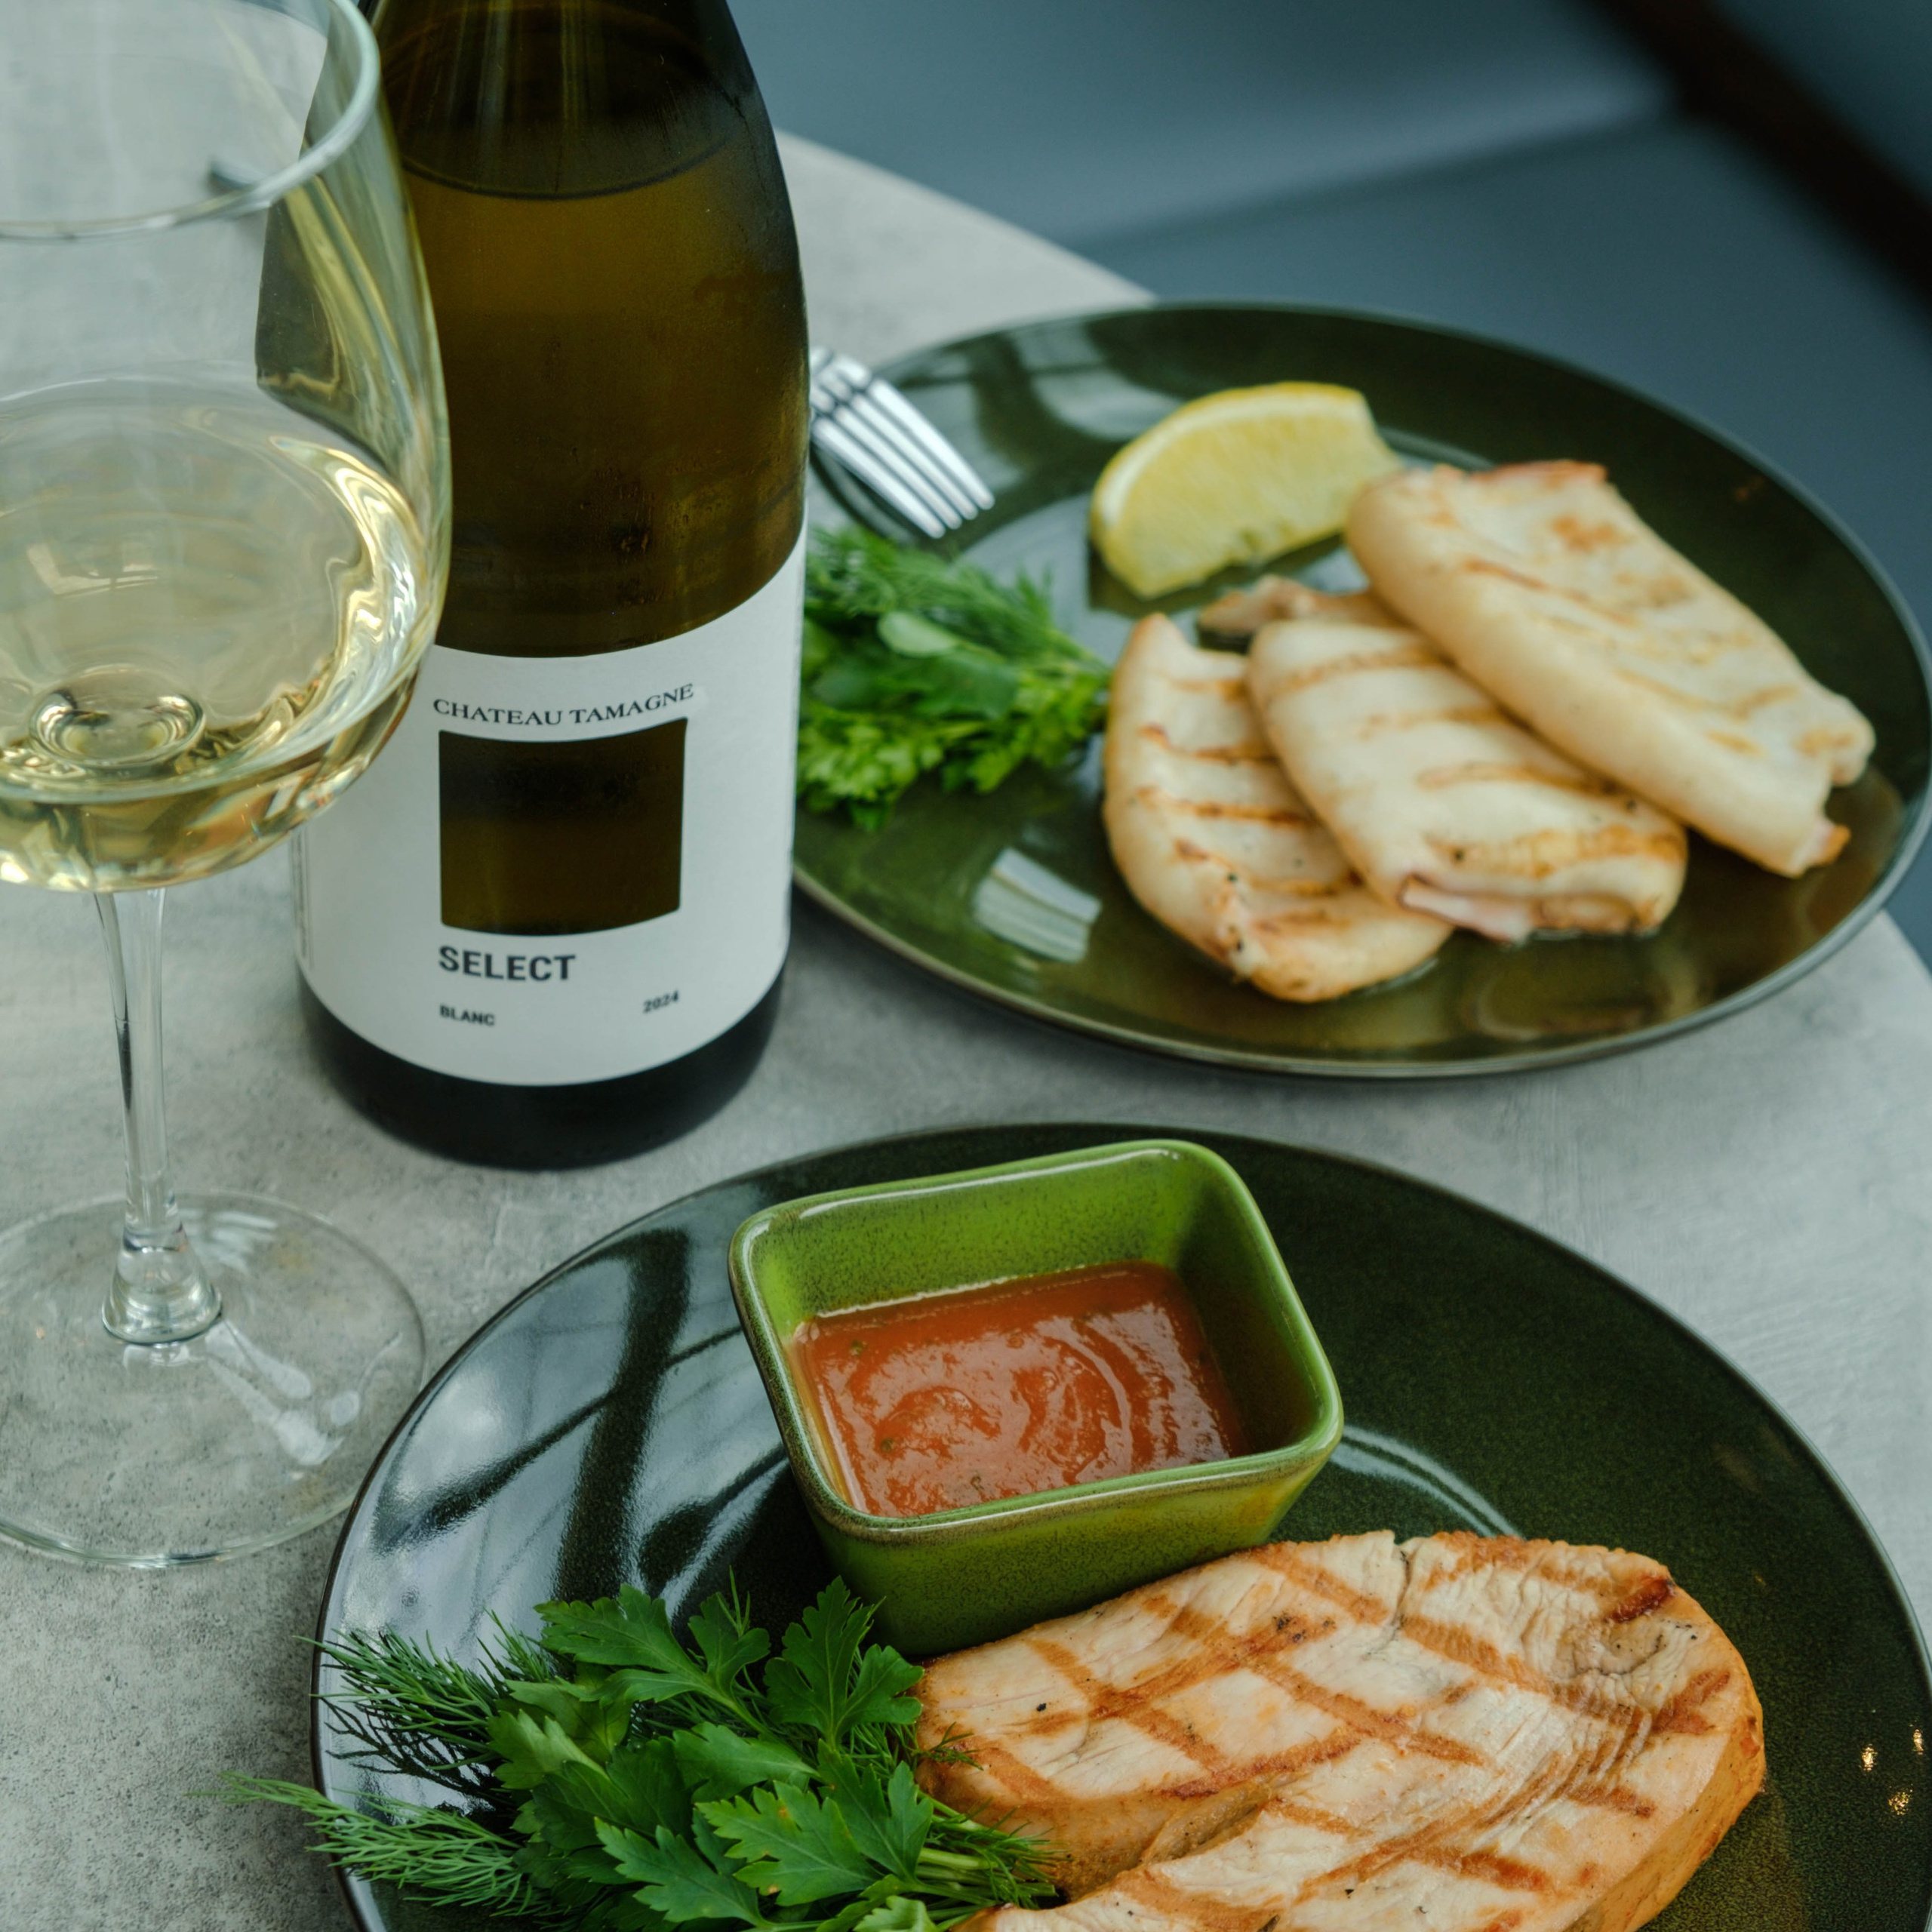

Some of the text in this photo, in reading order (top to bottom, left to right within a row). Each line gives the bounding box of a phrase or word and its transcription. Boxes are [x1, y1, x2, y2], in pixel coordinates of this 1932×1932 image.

[433, 684, 694, 725] CHATEAU TAMAGNE
[439, 946, 576, 981] SELECT
[439, 1004, 495, 1026] BLANC
[642, 989, 679, 1014] 2024
